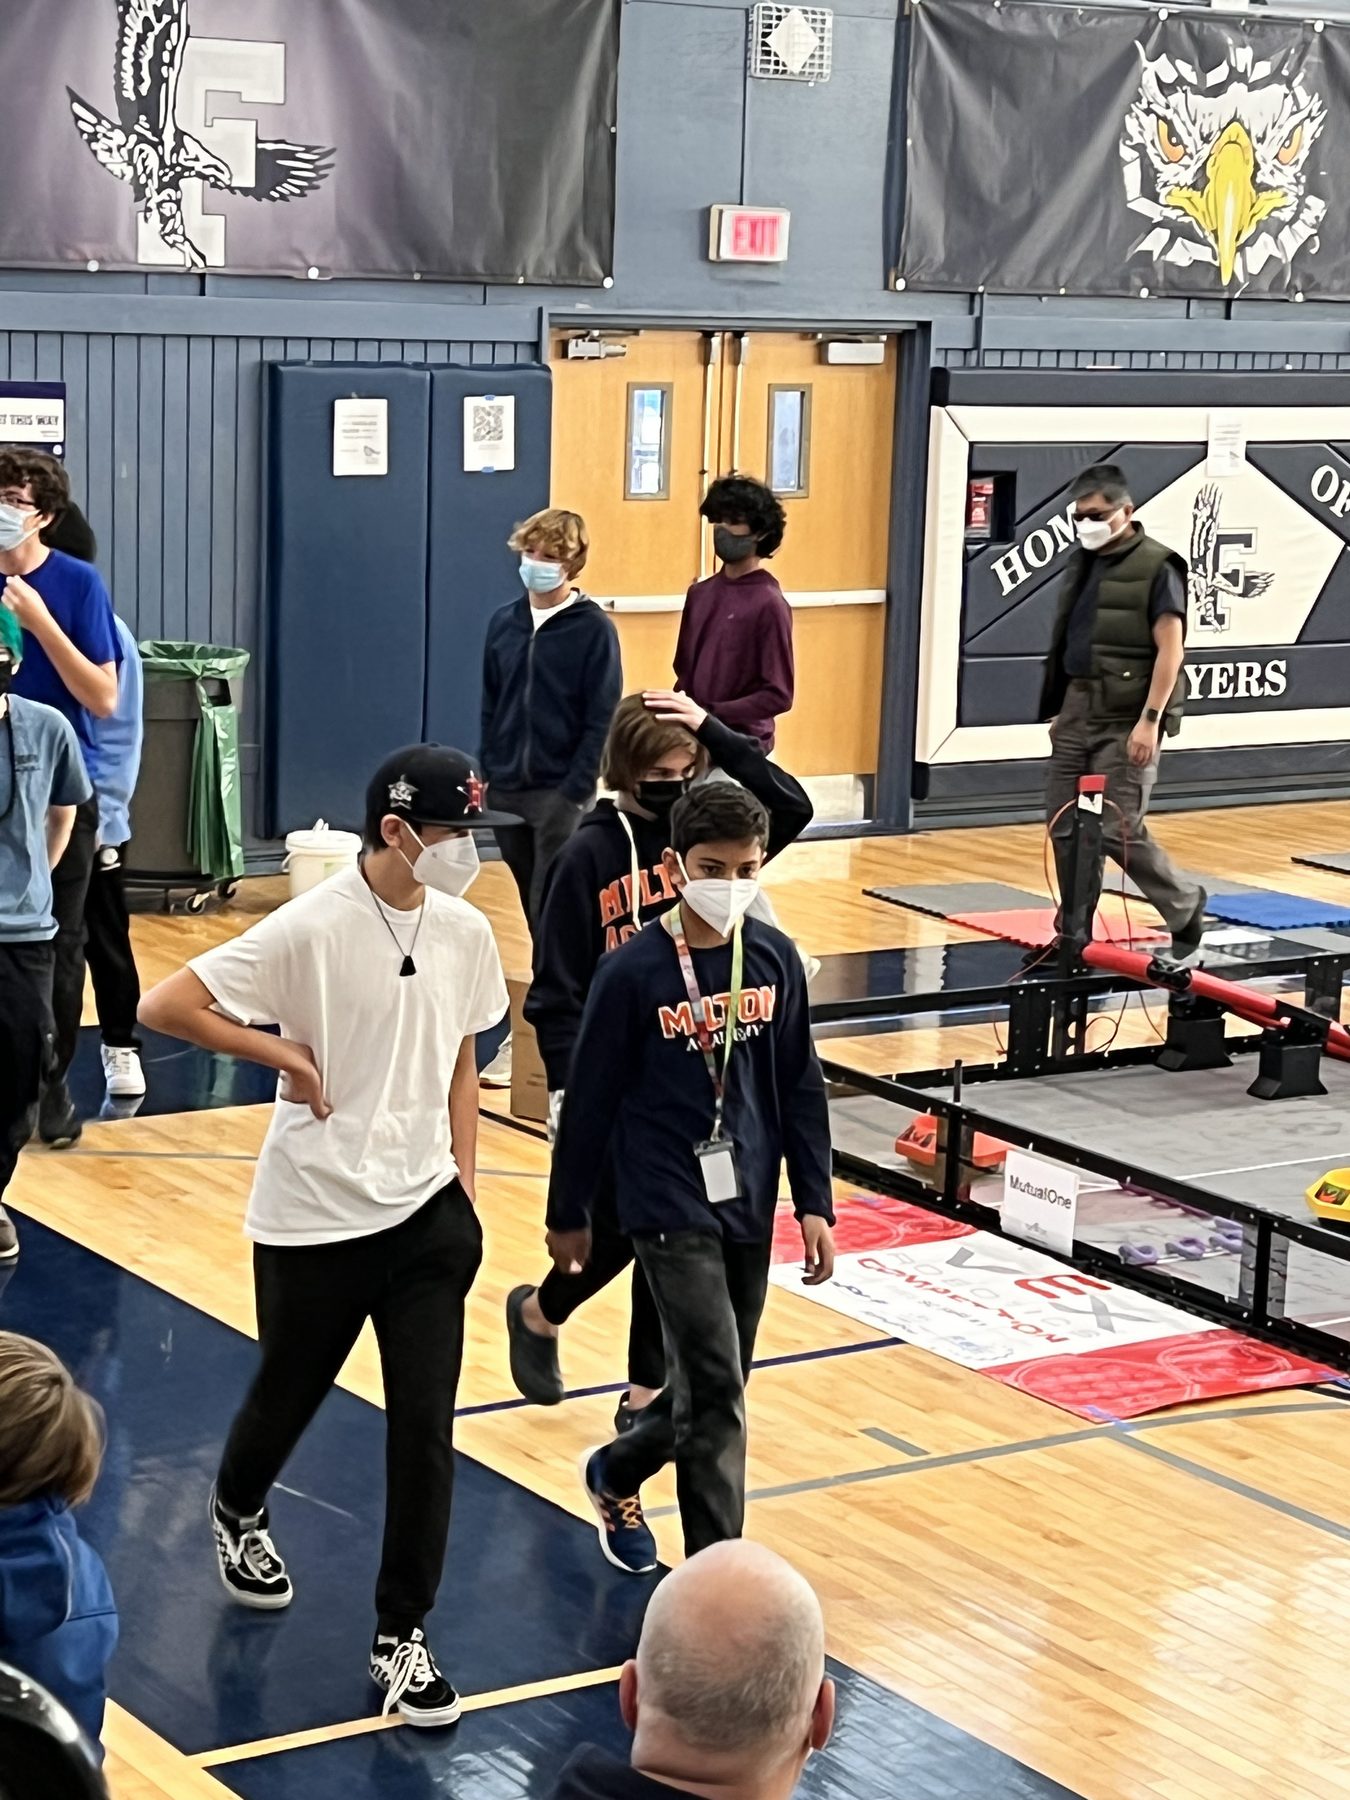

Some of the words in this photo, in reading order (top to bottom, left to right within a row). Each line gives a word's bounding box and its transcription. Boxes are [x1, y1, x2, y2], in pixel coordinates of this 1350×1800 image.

[990, 500, 1077, 597] HOM
[1183, 660, 1287, 700] YERS
[599, 863, 677, 928] MILT
[658, 984, 776, 1040] MLTON
[1009, 1174, 1072, 1210] MutualOne
[857, 1258, 1071, 1343] COMPETTION
